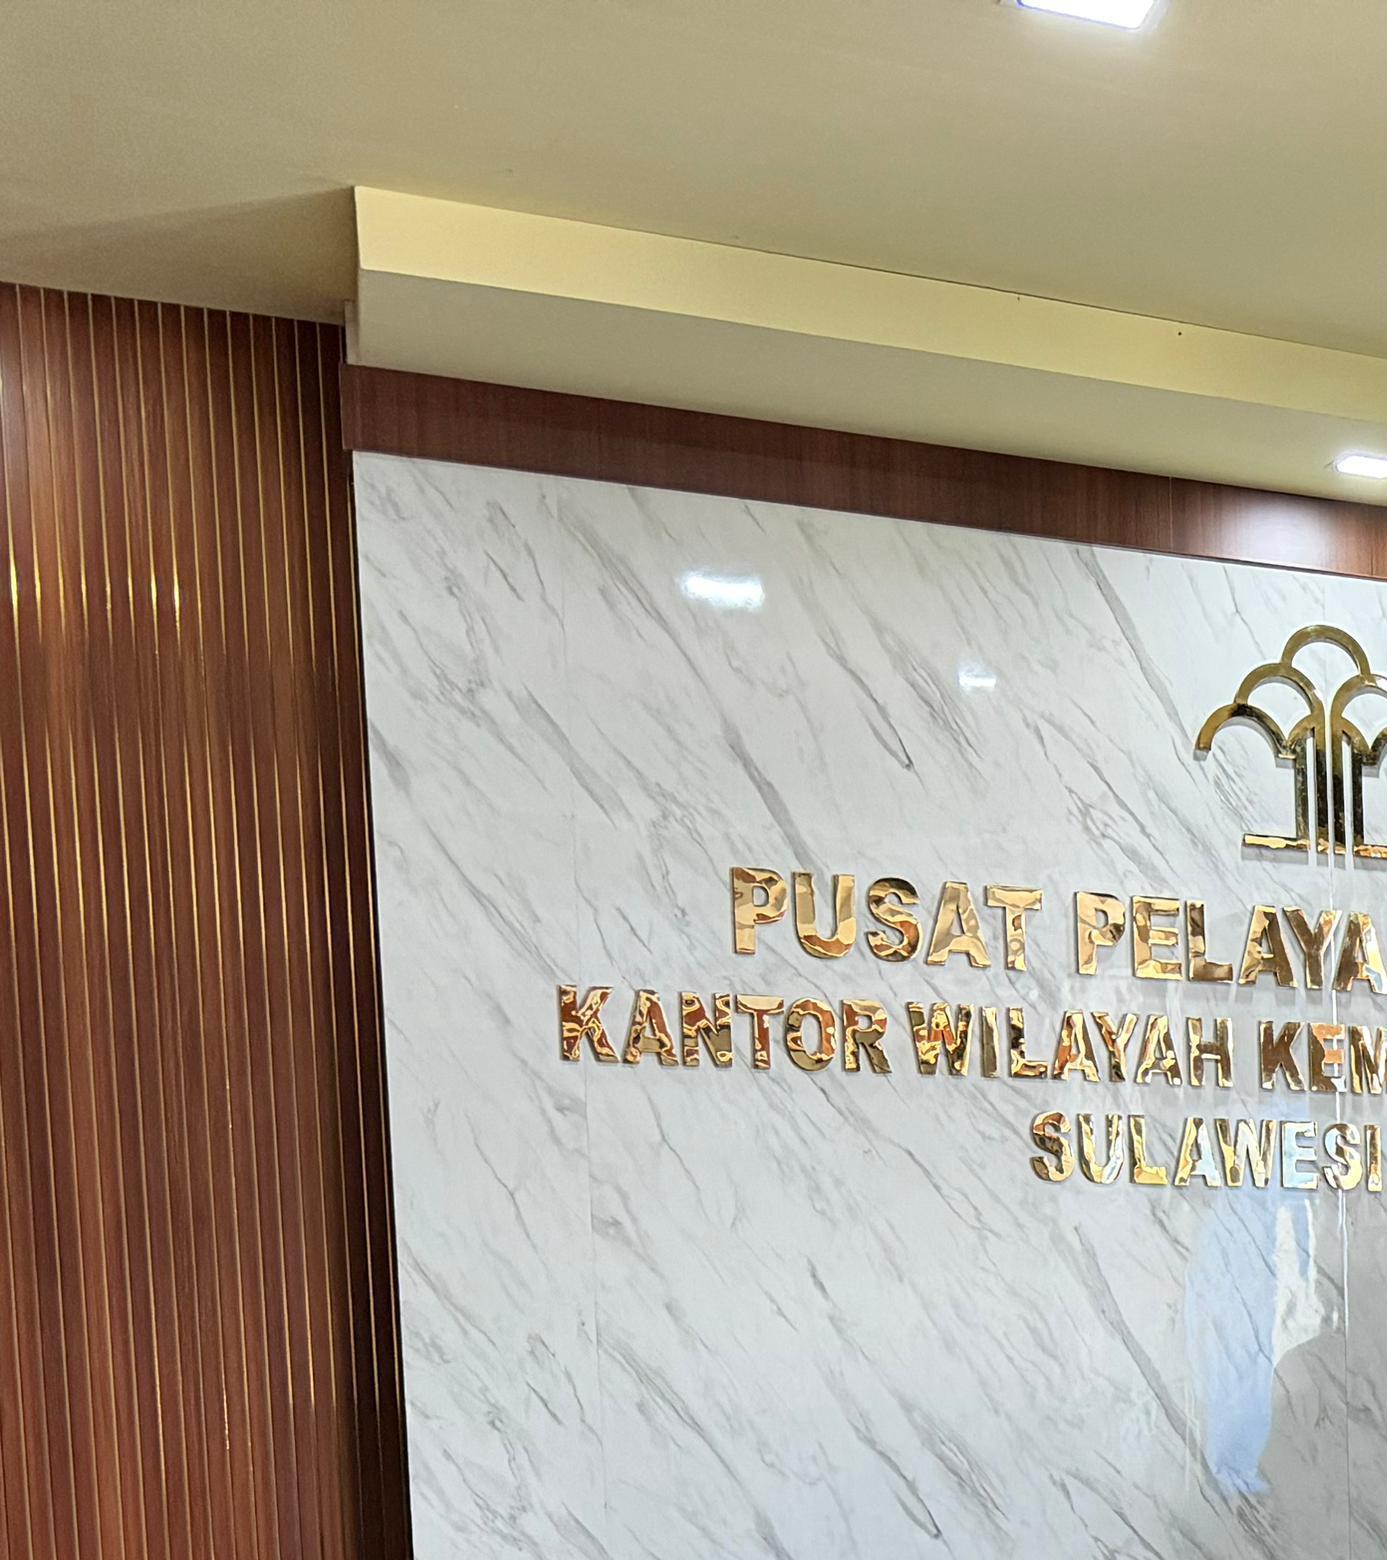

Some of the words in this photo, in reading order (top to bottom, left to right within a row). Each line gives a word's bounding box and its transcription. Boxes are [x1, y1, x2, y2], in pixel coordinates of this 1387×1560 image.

[729, 866, 1043, 972] PUSAT
[557, 984, 893, 1074] KANTOR
[906, 1001, 1234, 1089] WILAYAH
[1029, 1111, 1382, 1194] SULAWESI
